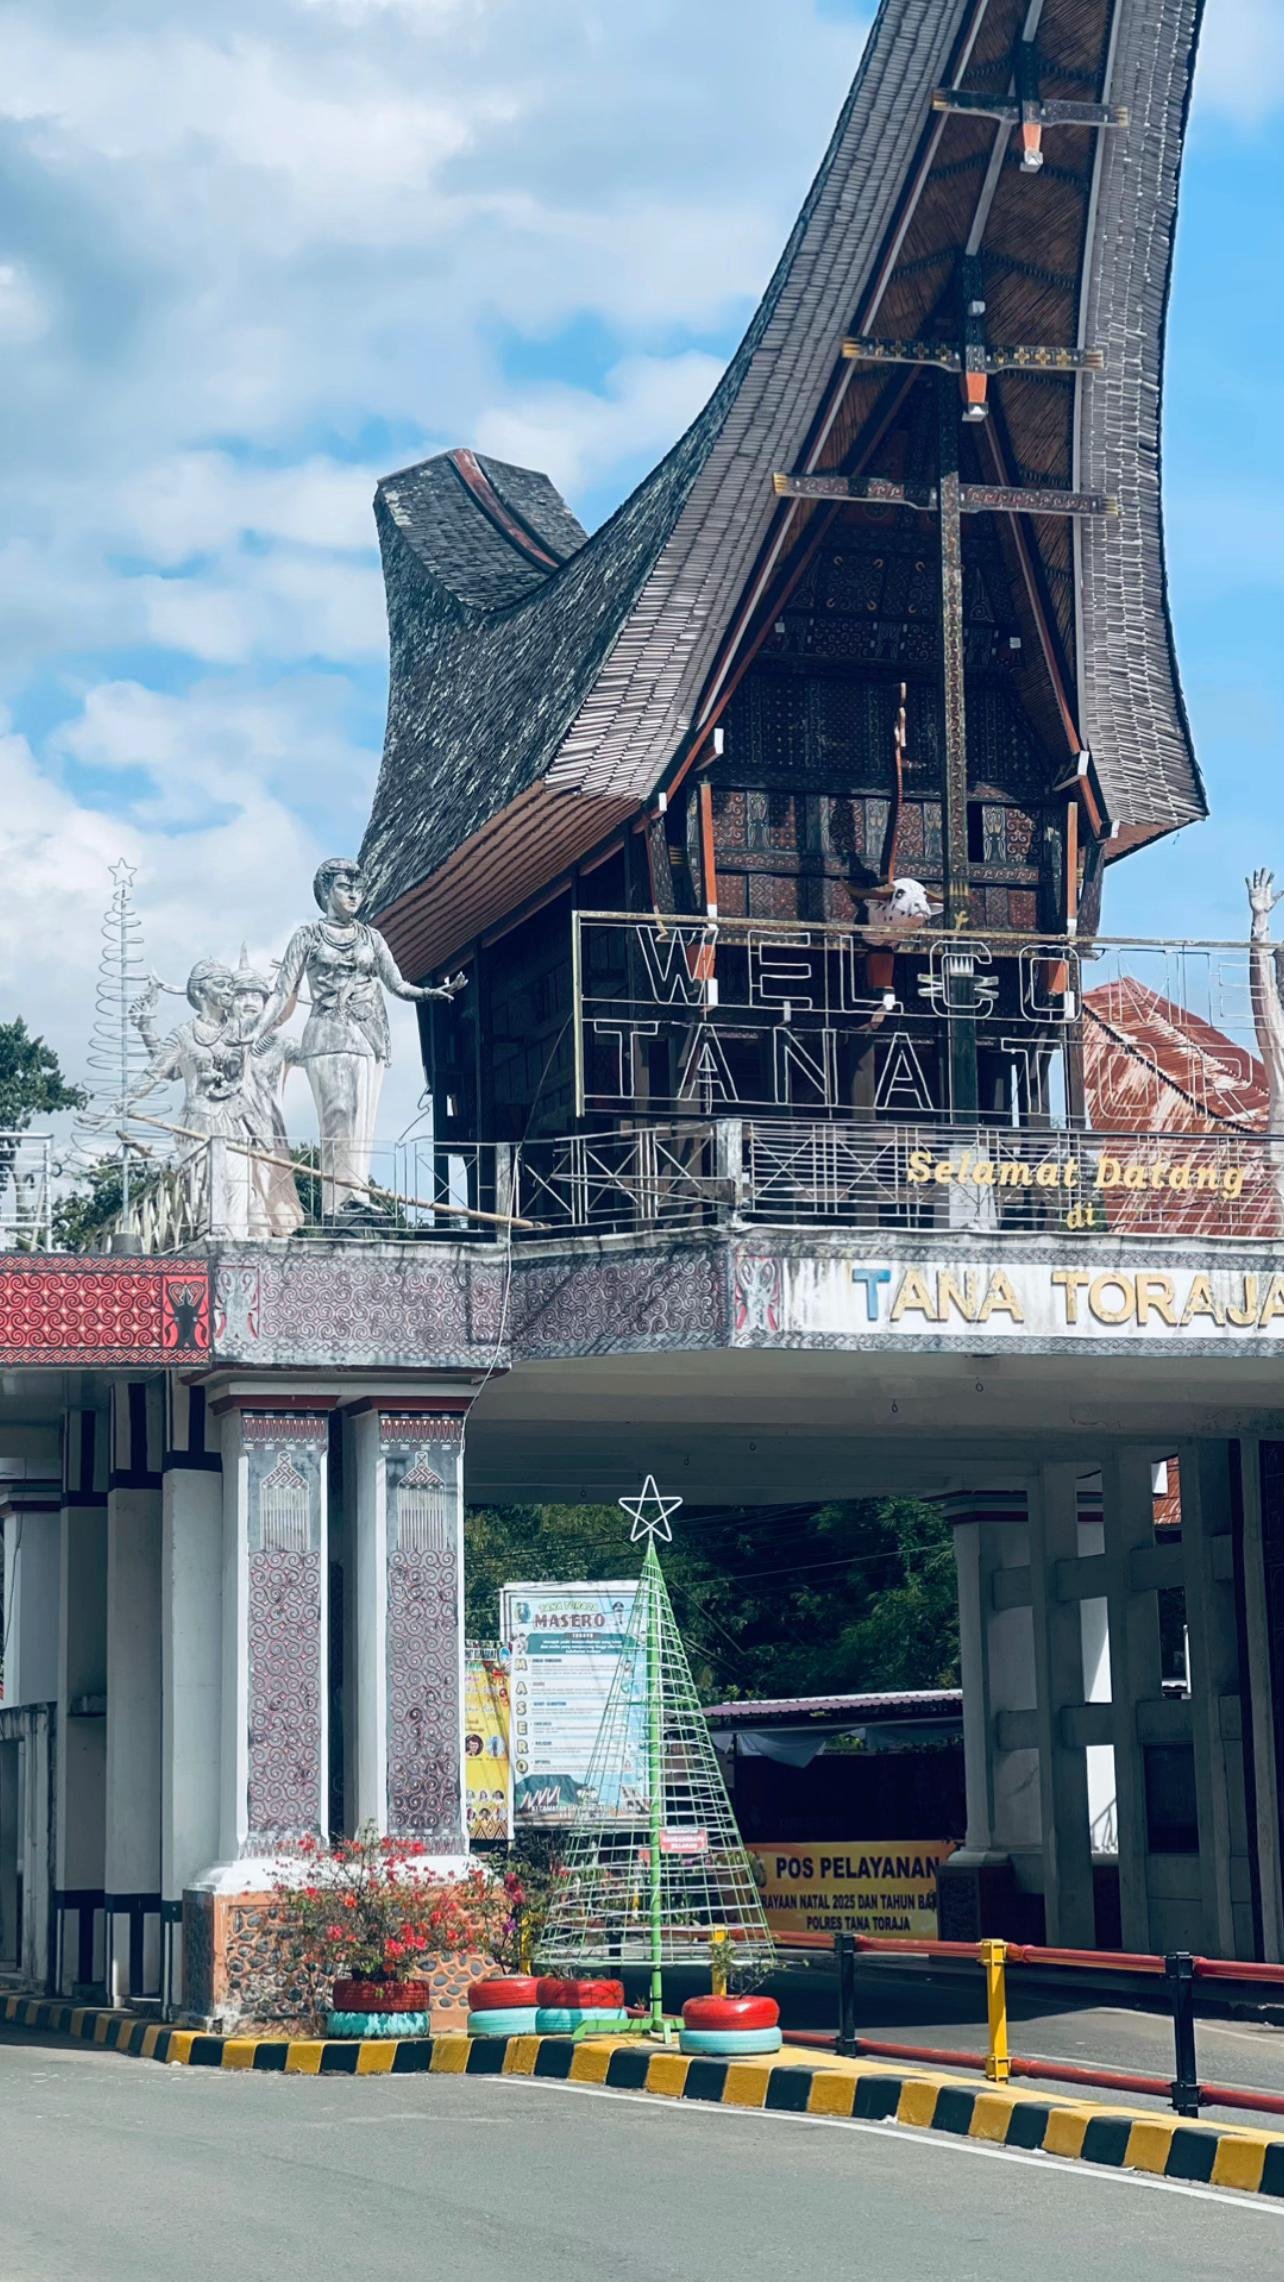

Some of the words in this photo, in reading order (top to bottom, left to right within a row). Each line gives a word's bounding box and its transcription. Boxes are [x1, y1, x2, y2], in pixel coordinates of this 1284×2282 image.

[635, 924, 1268, 1023] WELCOME
[594, 1019, 934, 1111] TANA
[906, 1151, 1080, 1189] Selamat
[1092, 1156, 1245, 1199] Datang
[1066, 1203, 1096, 1230] di
[852, 1268, 1025, 1323] TANA
[1051, 1270, 1284, 1329] TORAJA
[534, 1614, 606, 1628] MASERO
[776, 1857, 814, 1879] POS
[820, 1857, 939, 1879] PELAYANAN
[800, 1894, 830, 1910] NATAL
[832, 1894, 855, 1909] 2025
[858, 1894, 880, 1910] DAN
[881, 1894, 915, 1910] TAHUN
[806, 1916, 842, 1931] POLRES
[844, 1916, 870, 1931] TANA
[873, 1916, 911, 1931] TORAJA
